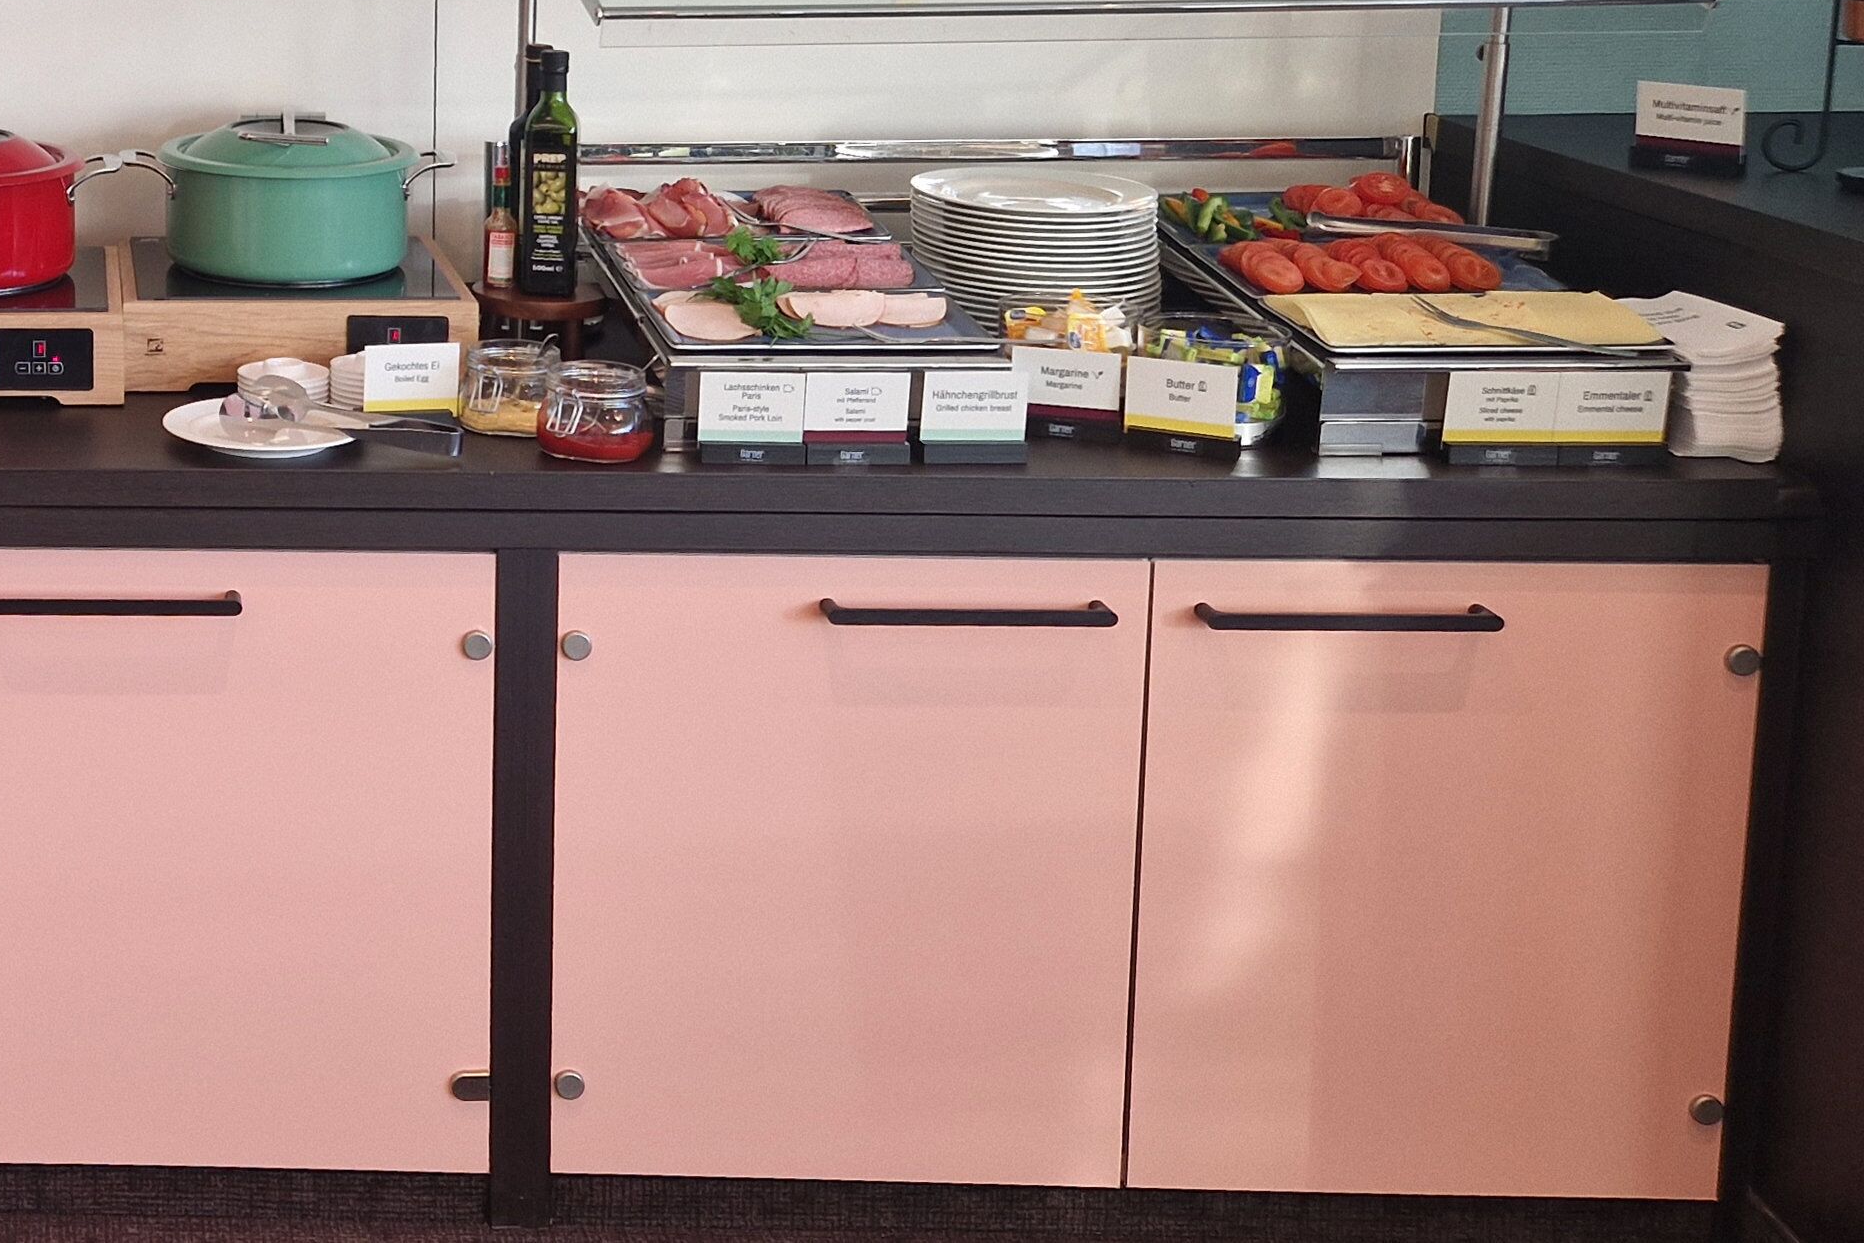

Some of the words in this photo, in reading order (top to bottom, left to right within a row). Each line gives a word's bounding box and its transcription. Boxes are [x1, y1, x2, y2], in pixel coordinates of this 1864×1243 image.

[384, 361, 429, 371] Gekochtes
[431, 360, 440, 370] Ei
[1040, 366, 1089, 378] Margarine
[723, 383, 780, 391] Lachsschinken
[1045, 380, 1083, 390] Margarine
[1166, 378, 1196, 391] Butter
[741, 392, 762, 400] Paris
[845, 387, 869, 396] Salami
[932, 389, 1018, 401] Hähnchengrillbrust
[1582, 390, 1642, 401] Emmentaler
[1168, 393, 1191, 403] Butter
[749, 414, 766, 422] Pork
